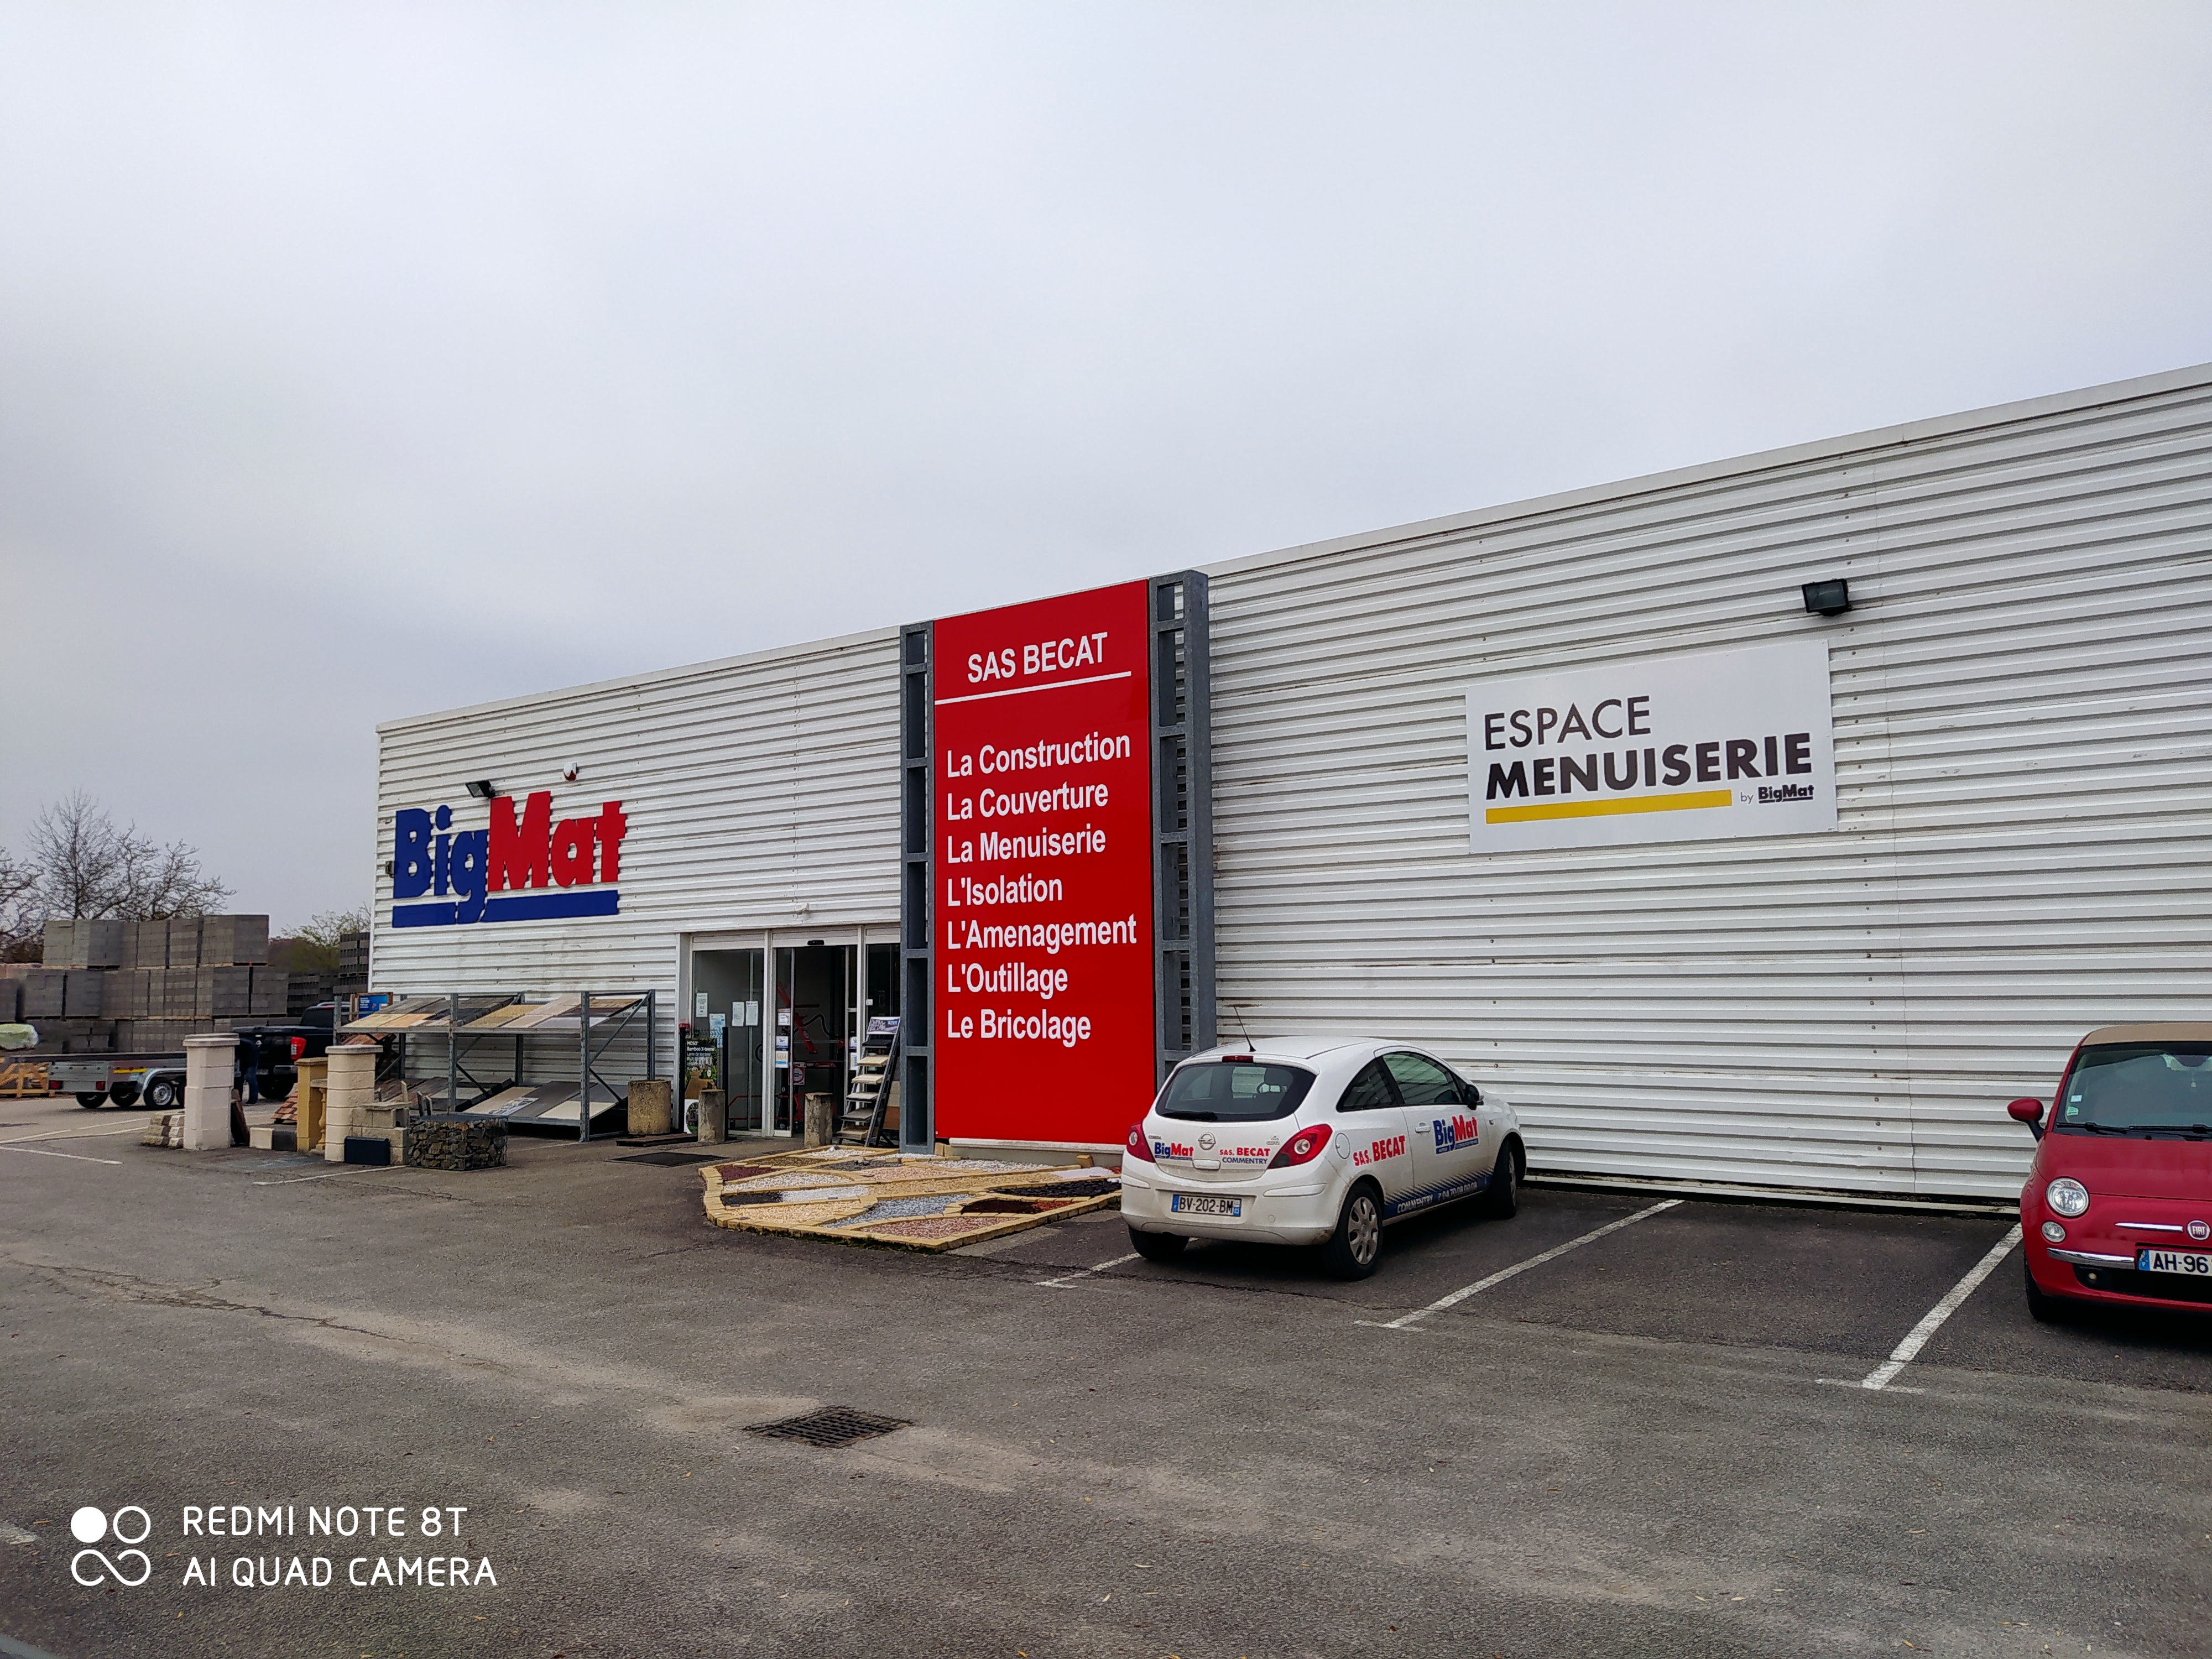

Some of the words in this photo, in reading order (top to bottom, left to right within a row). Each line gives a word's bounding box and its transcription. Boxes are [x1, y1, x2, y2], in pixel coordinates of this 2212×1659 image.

[968, 648, 1016, 683] SAS
[1024, 632, 1108, 675] BECAT
[1484, 695, 1651, 750] ESPACE
[947, 750, 973, 778] La
[979, 732, 1130, 774] Construction
[1485, 732, 1812, 800] MENUISERIE
[947, 793, 973, 821] La
[979, 781, 1108, 817] Couverture
[1740, 791, 1754, 804] by
[1758, 784, 1814, 803] BigMat
[393, 791, 626, 924] BigMat
[947, 836, 973, 863] La
[980, 823, 1106, 861] Menuiserie
[948, 873, 1062, 906] L'Isolation
[948, 914, 1137, 954] L'Amenagement
[948, 962, 1068, 1000] L'Outillage
[948, 1009, 973, 1039] Le
[980, 1009, 1091, 1048] Bricolage
[1155, 1142, 1194, 1158] BigMat
[1353, 1149, 1372, 1166] SAS.
[1371, 1135, 1406, 1162] BECAT
[1432, 1114, 1478, 1151] BigMat
[1237, 1147, 1271, 1157] BECAT
[1179, 1197, 1234, 1214] BV-202-BM
[2192, 1226, 2206, 1235] FIAT
